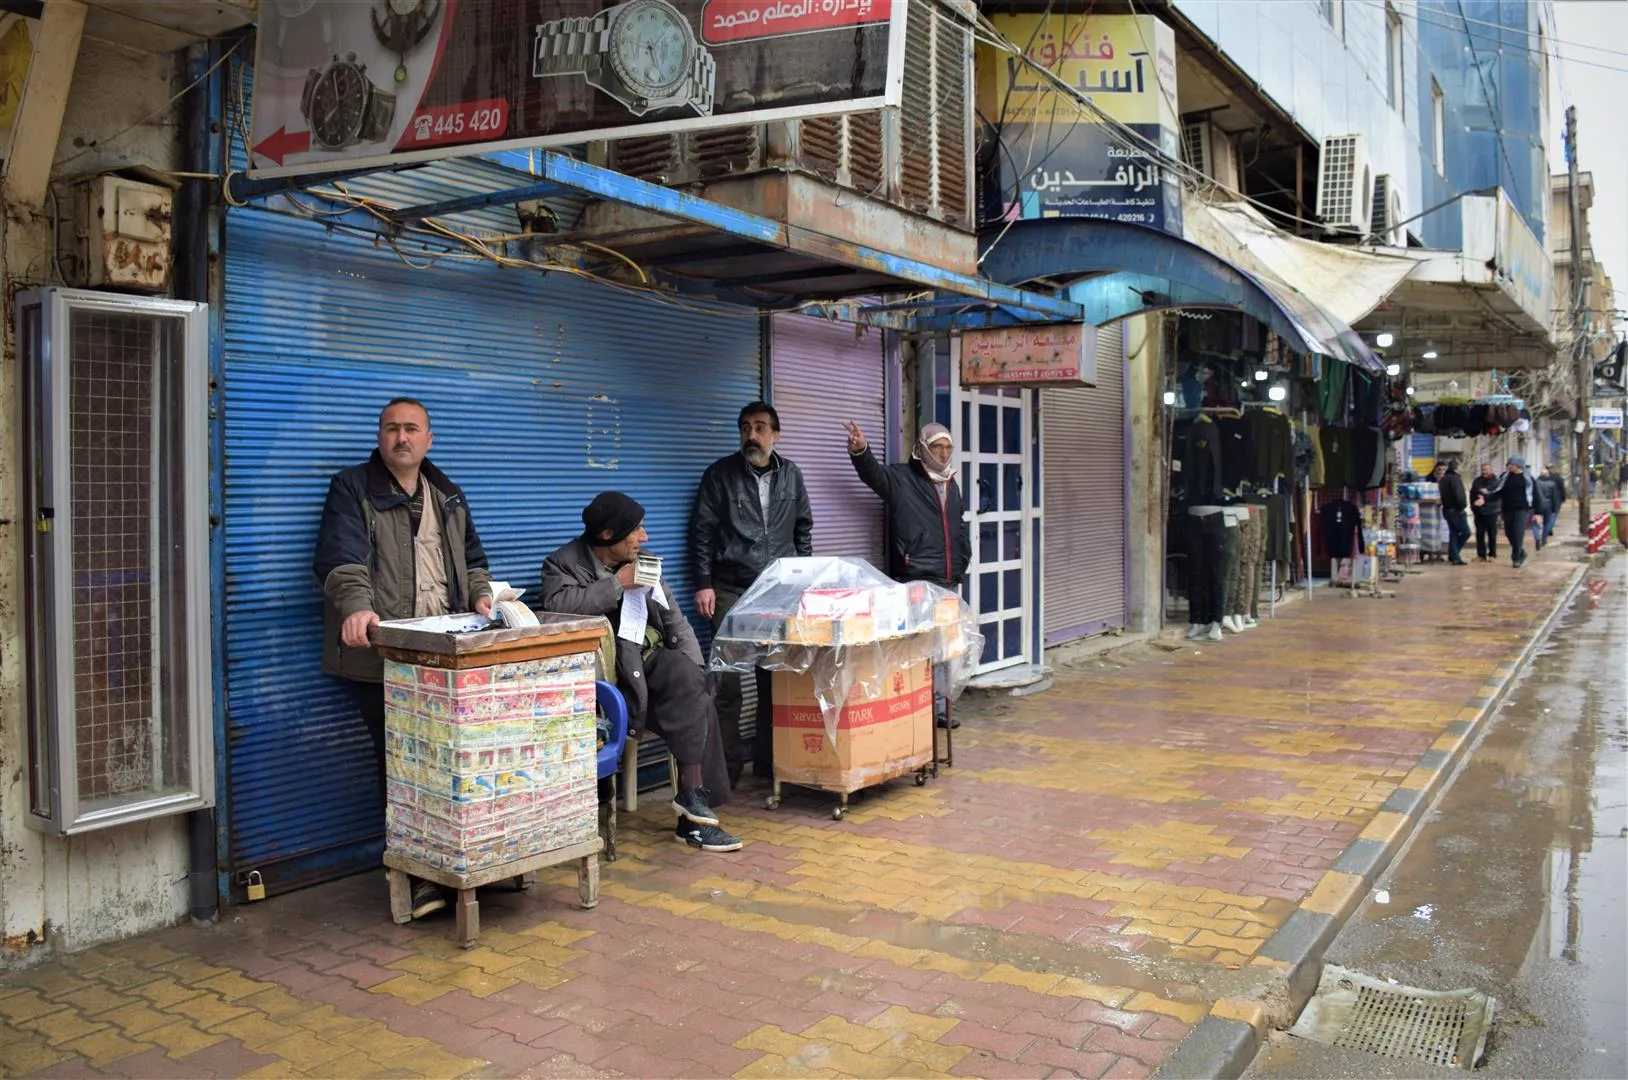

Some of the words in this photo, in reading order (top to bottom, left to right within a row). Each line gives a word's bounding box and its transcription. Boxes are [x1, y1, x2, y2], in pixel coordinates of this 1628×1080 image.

[713, 9, 760, 28] محمد
[762, 0, 812, 25] المعلم
[1029, 34, 1115, 68] فندق
[1007, 51, 1150, 102] آسيا
[434, 113, 465, 136] 445
[469, 108, 501, 132] 420
[1031, 164, 1160, 192] الرافدين
